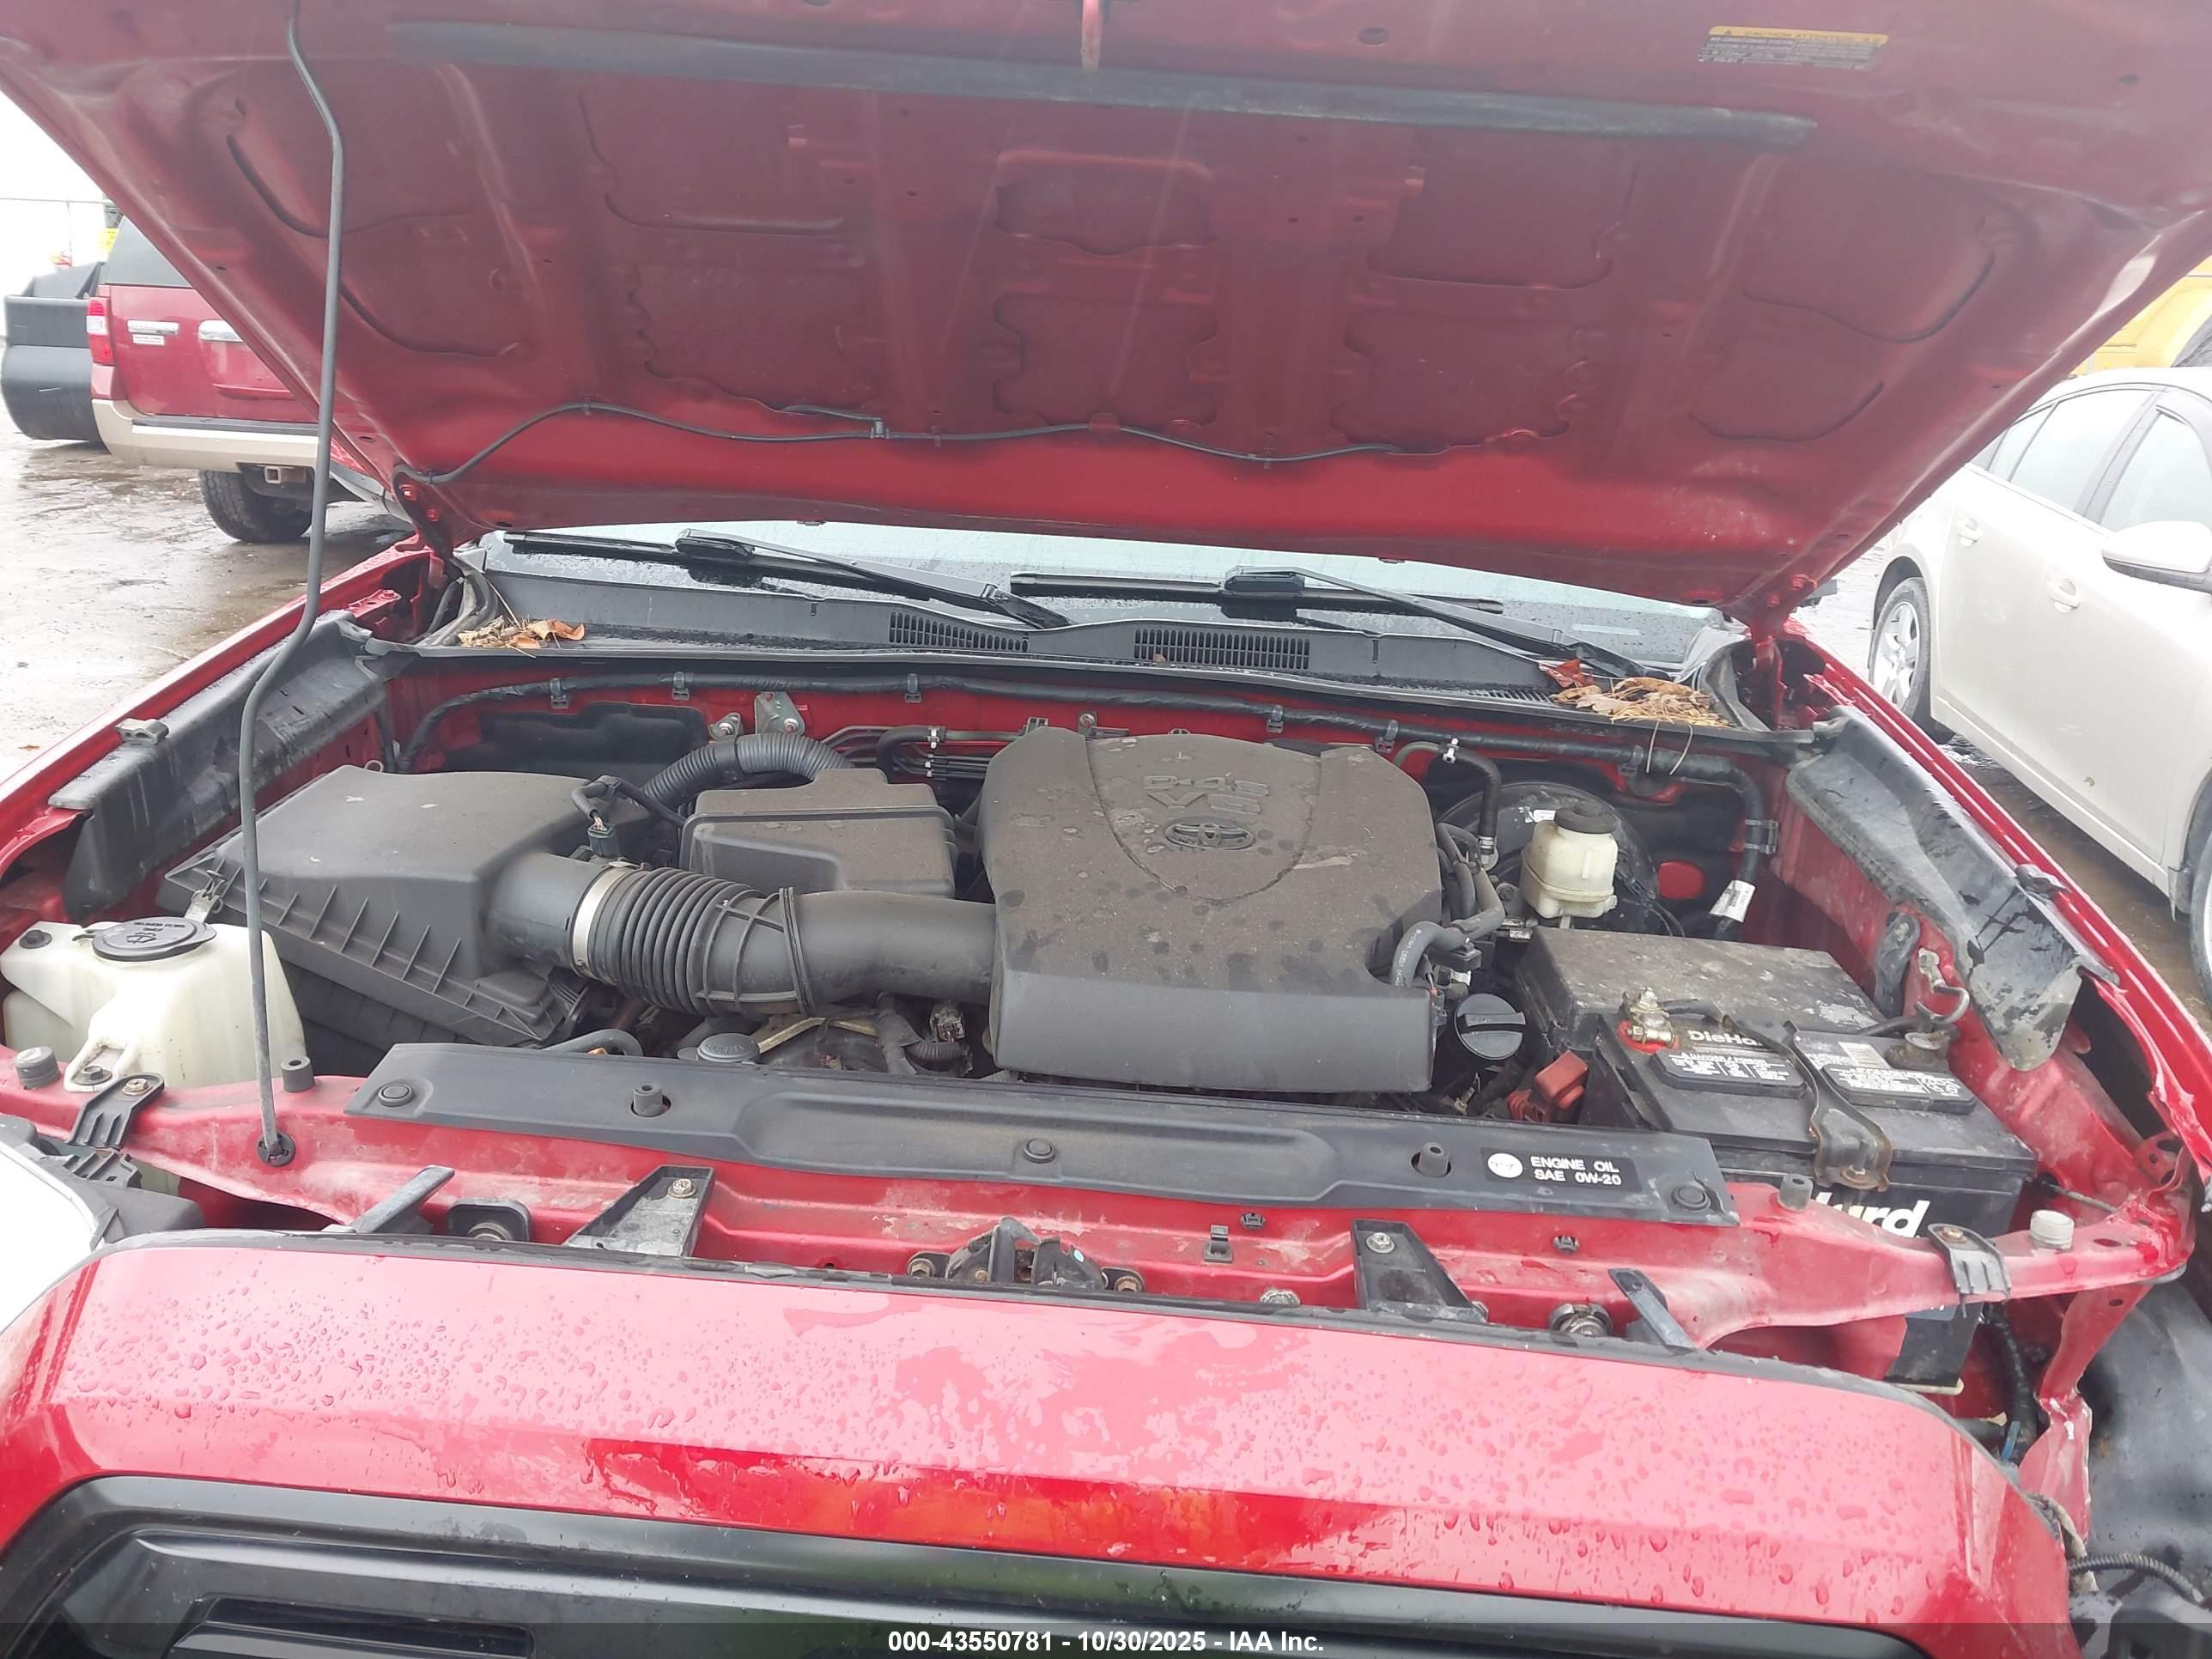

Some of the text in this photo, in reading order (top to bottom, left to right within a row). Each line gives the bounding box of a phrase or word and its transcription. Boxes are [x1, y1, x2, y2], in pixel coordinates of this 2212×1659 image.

[1688, 1030, 1765, 1046] DieHa
[1530, 1156, 1619, 1173] ENGINE OIL
[1534, 1170, 1621, 1186] SAE 0W-20
